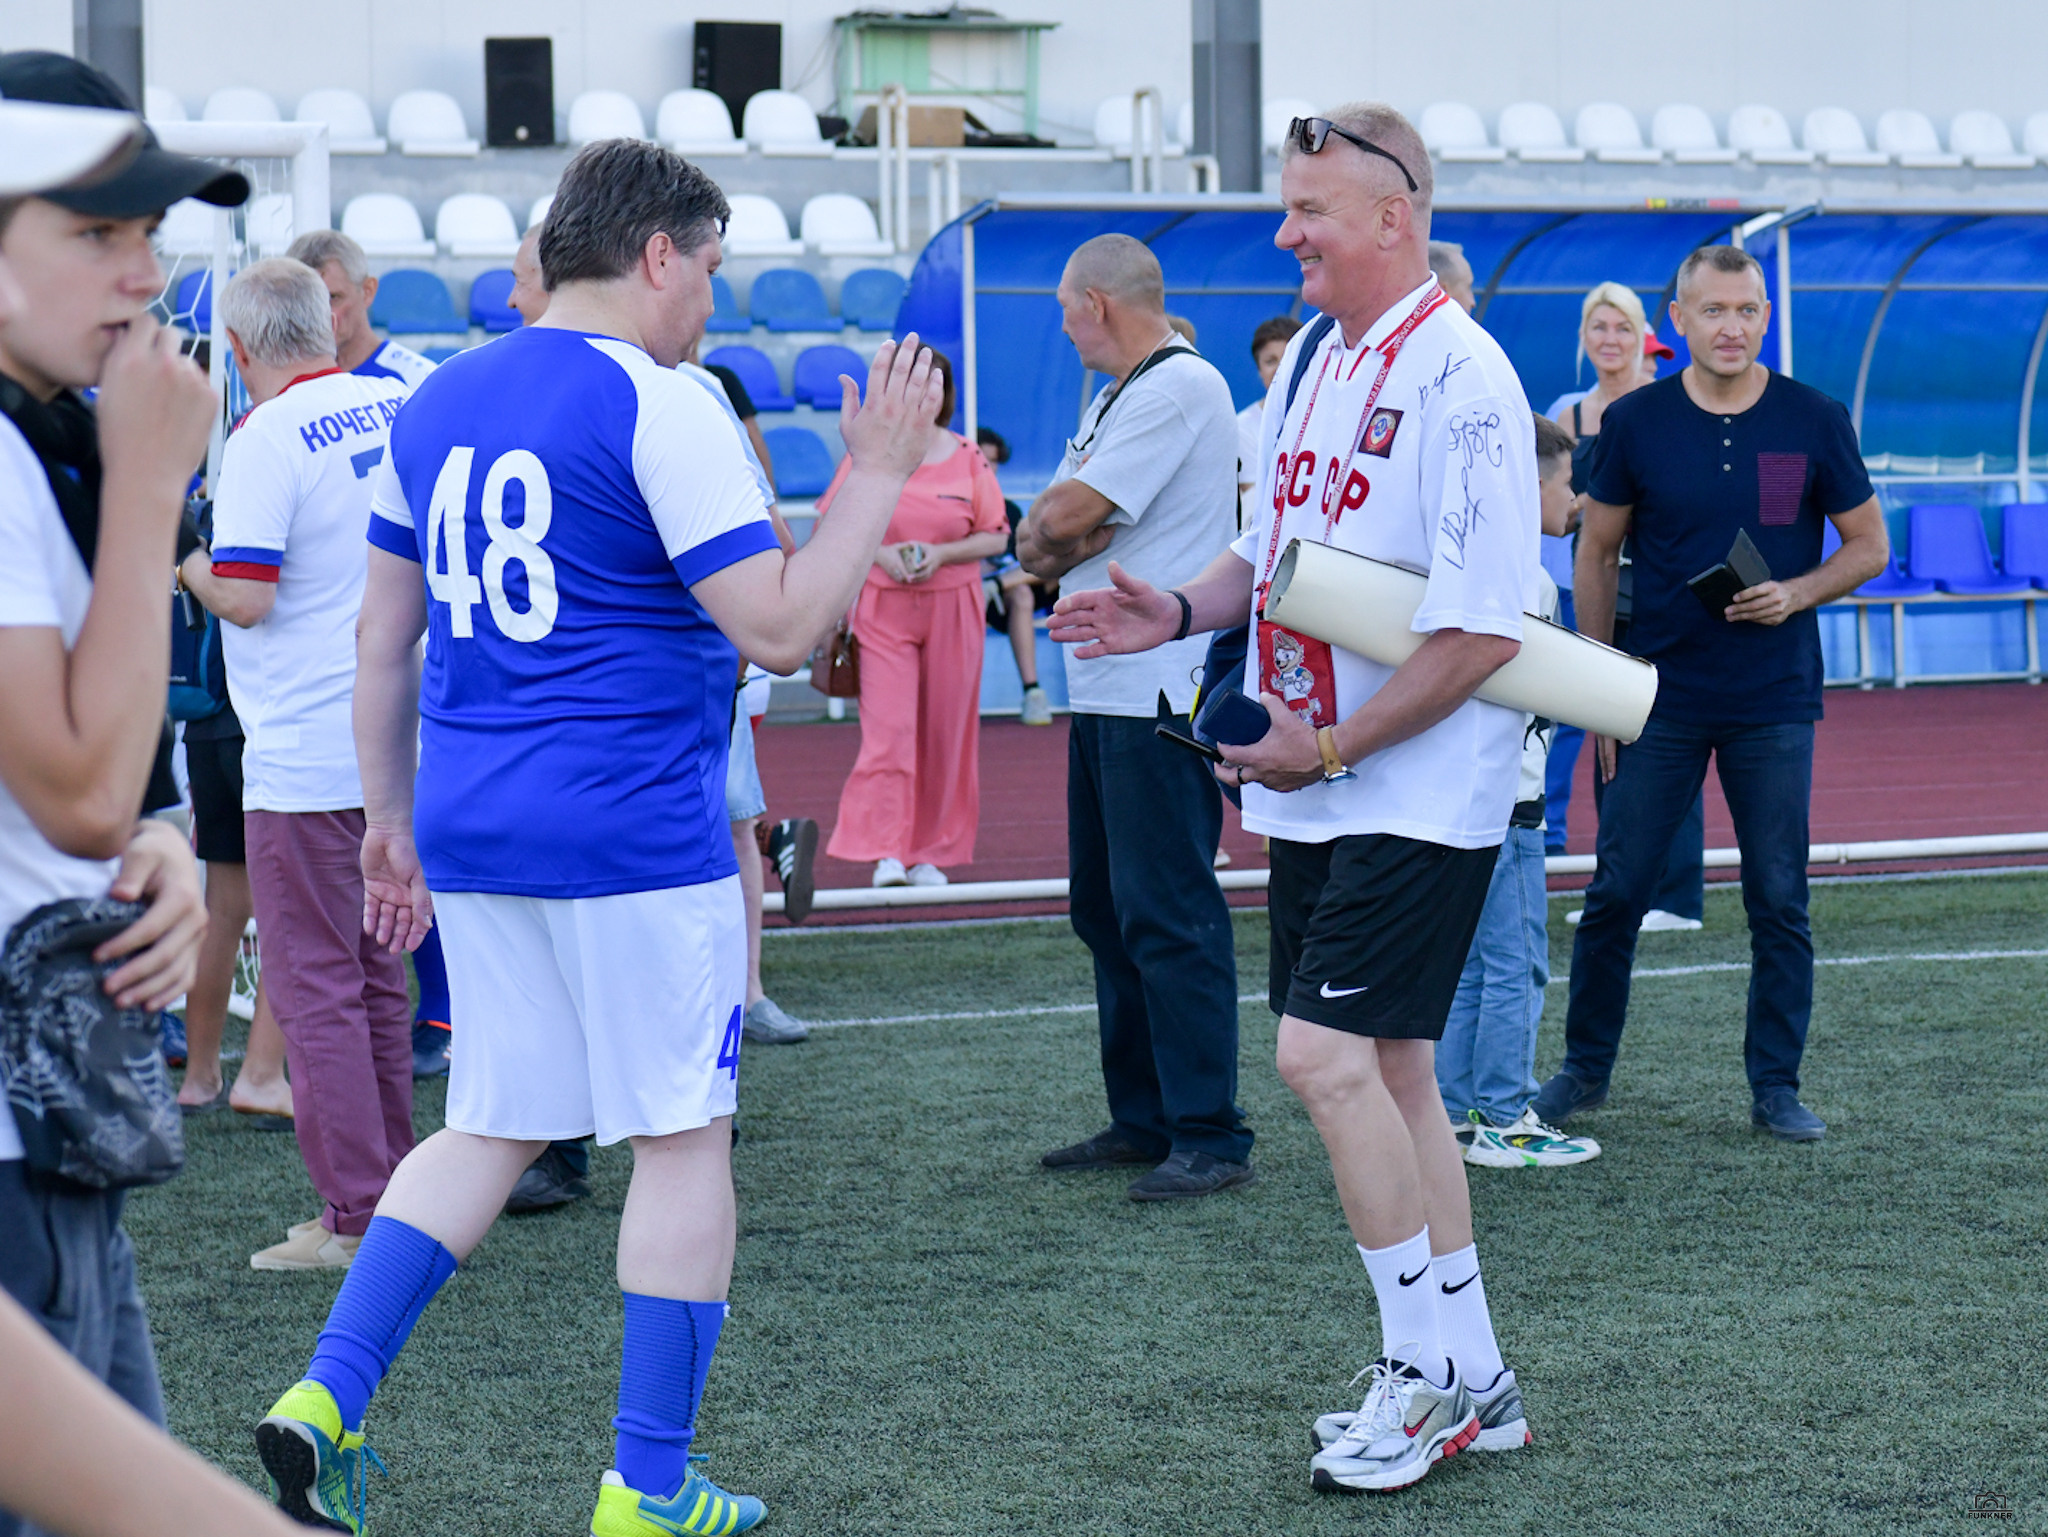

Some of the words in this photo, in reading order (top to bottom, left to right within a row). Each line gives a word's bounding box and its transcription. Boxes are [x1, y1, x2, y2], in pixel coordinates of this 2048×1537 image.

[299, 396, 405, 453] КОЧЕГАР
[1273, 450, 1370, 525] СССР
[426, 445, 559, 643] 48
